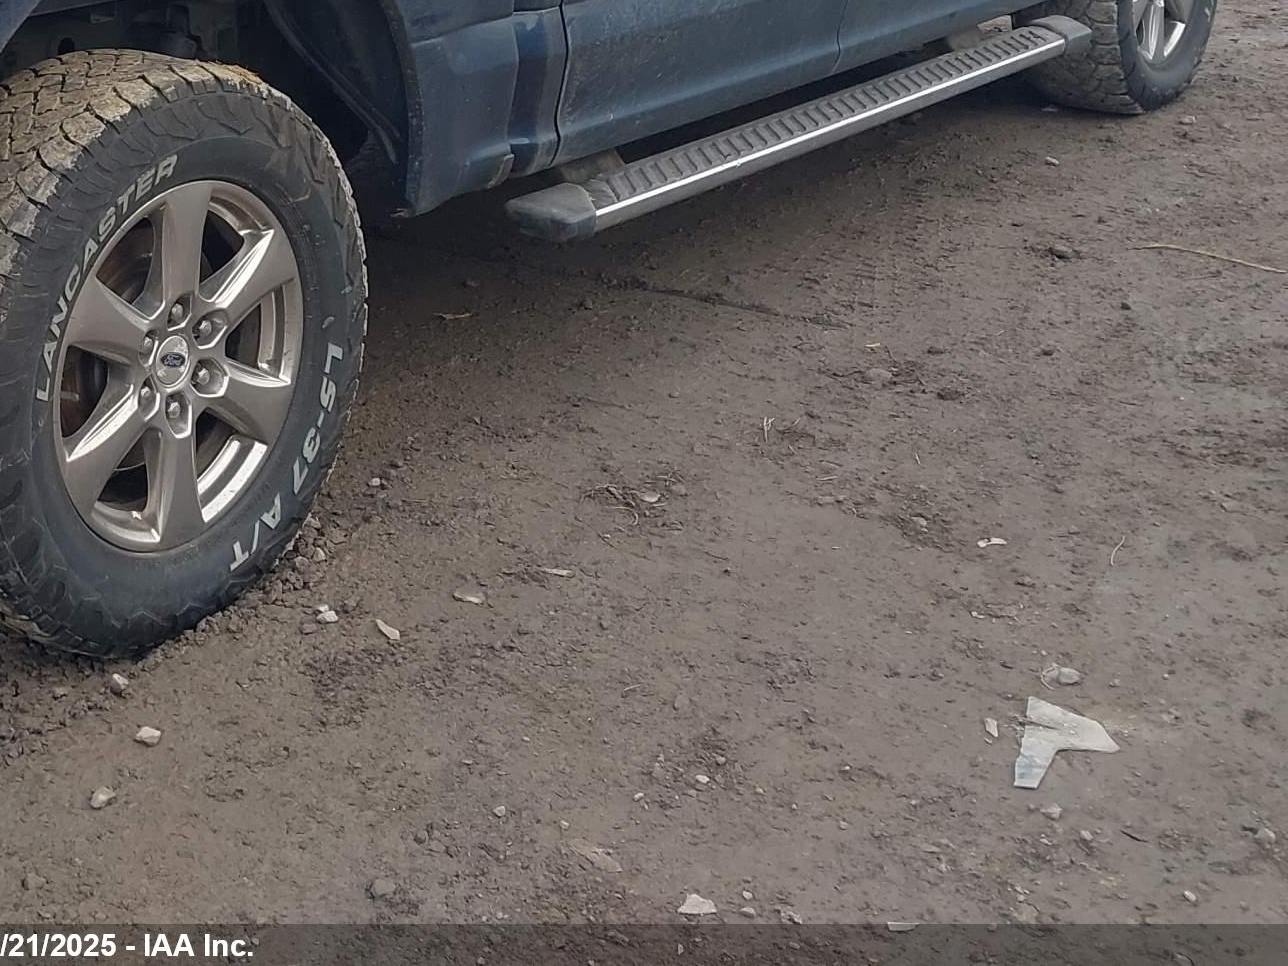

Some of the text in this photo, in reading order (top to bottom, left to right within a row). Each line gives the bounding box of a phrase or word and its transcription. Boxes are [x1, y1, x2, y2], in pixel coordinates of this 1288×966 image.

[37, 153, 178, 402] LANCASTER
[230, 342, 344, 572] LS-37 A/T
